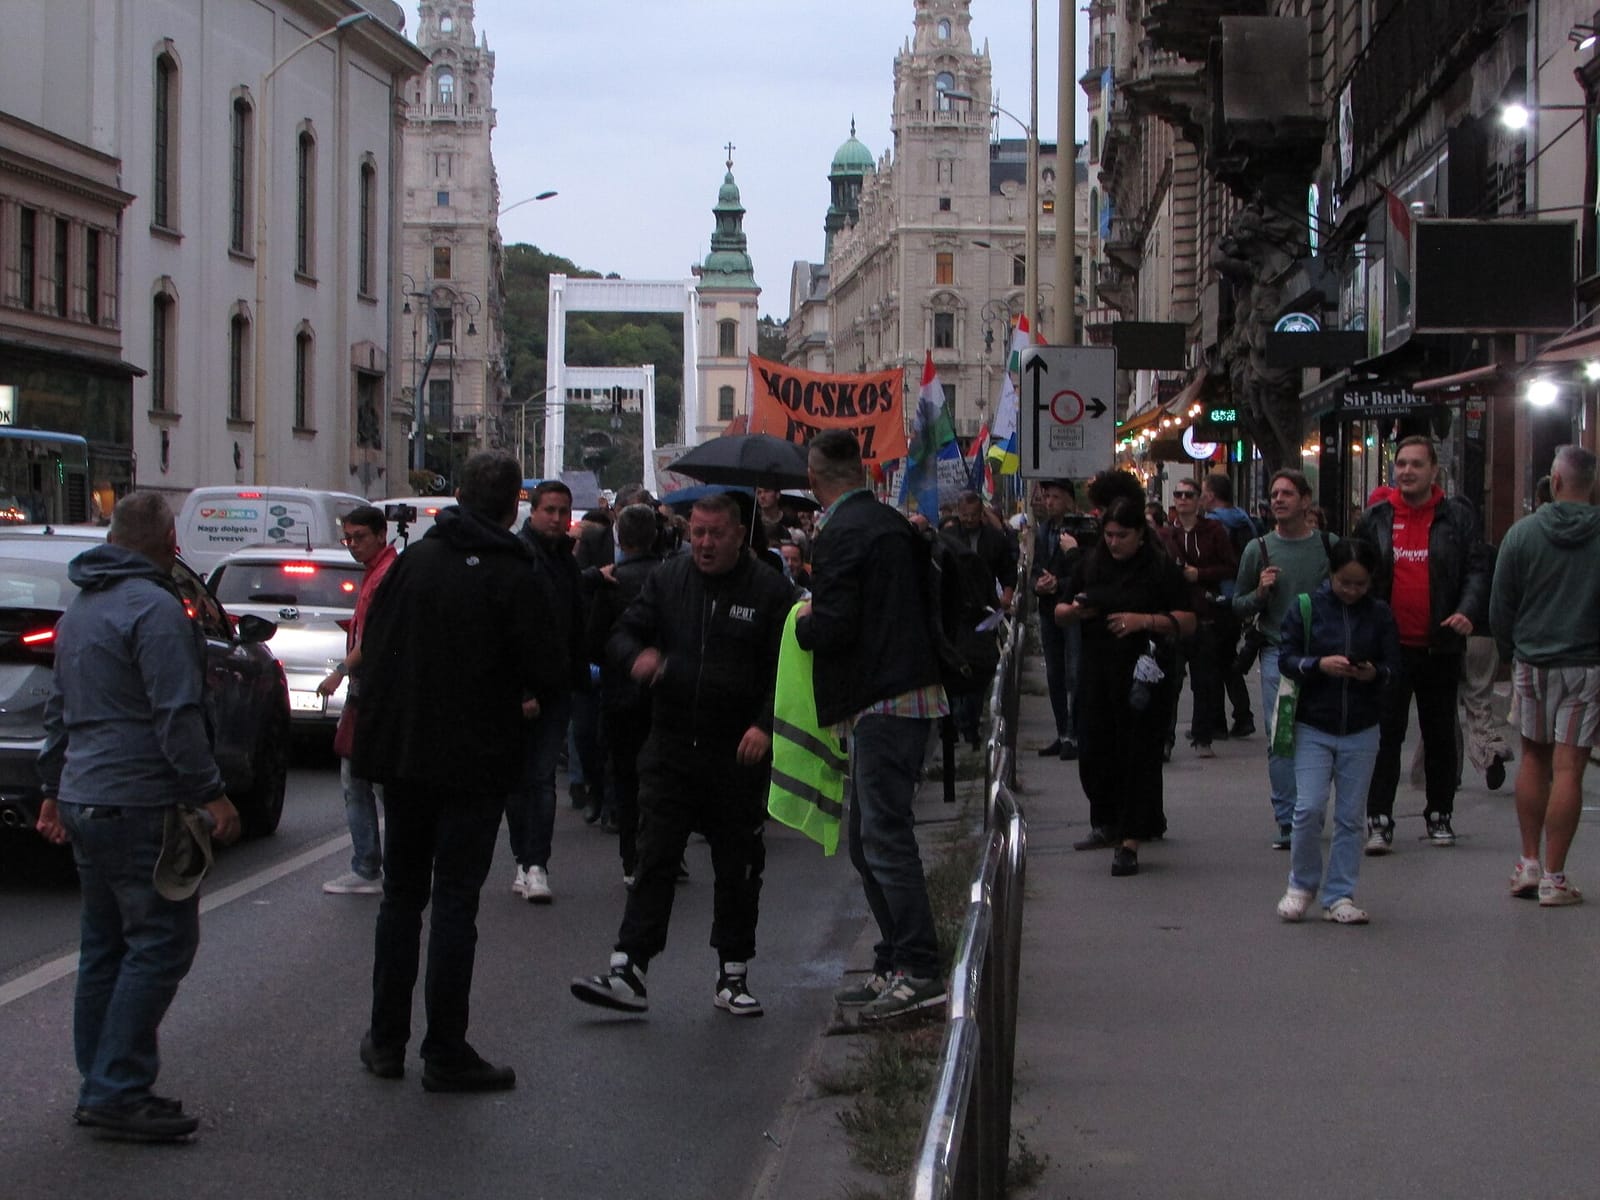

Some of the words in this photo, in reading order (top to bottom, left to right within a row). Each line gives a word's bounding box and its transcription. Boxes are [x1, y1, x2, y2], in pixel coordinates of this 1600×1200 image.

[759, 367, 893, 418] MOCSKOS
[1343, 391, 1368, 406] Sir
[197, 525, 219, 533] Nagy
